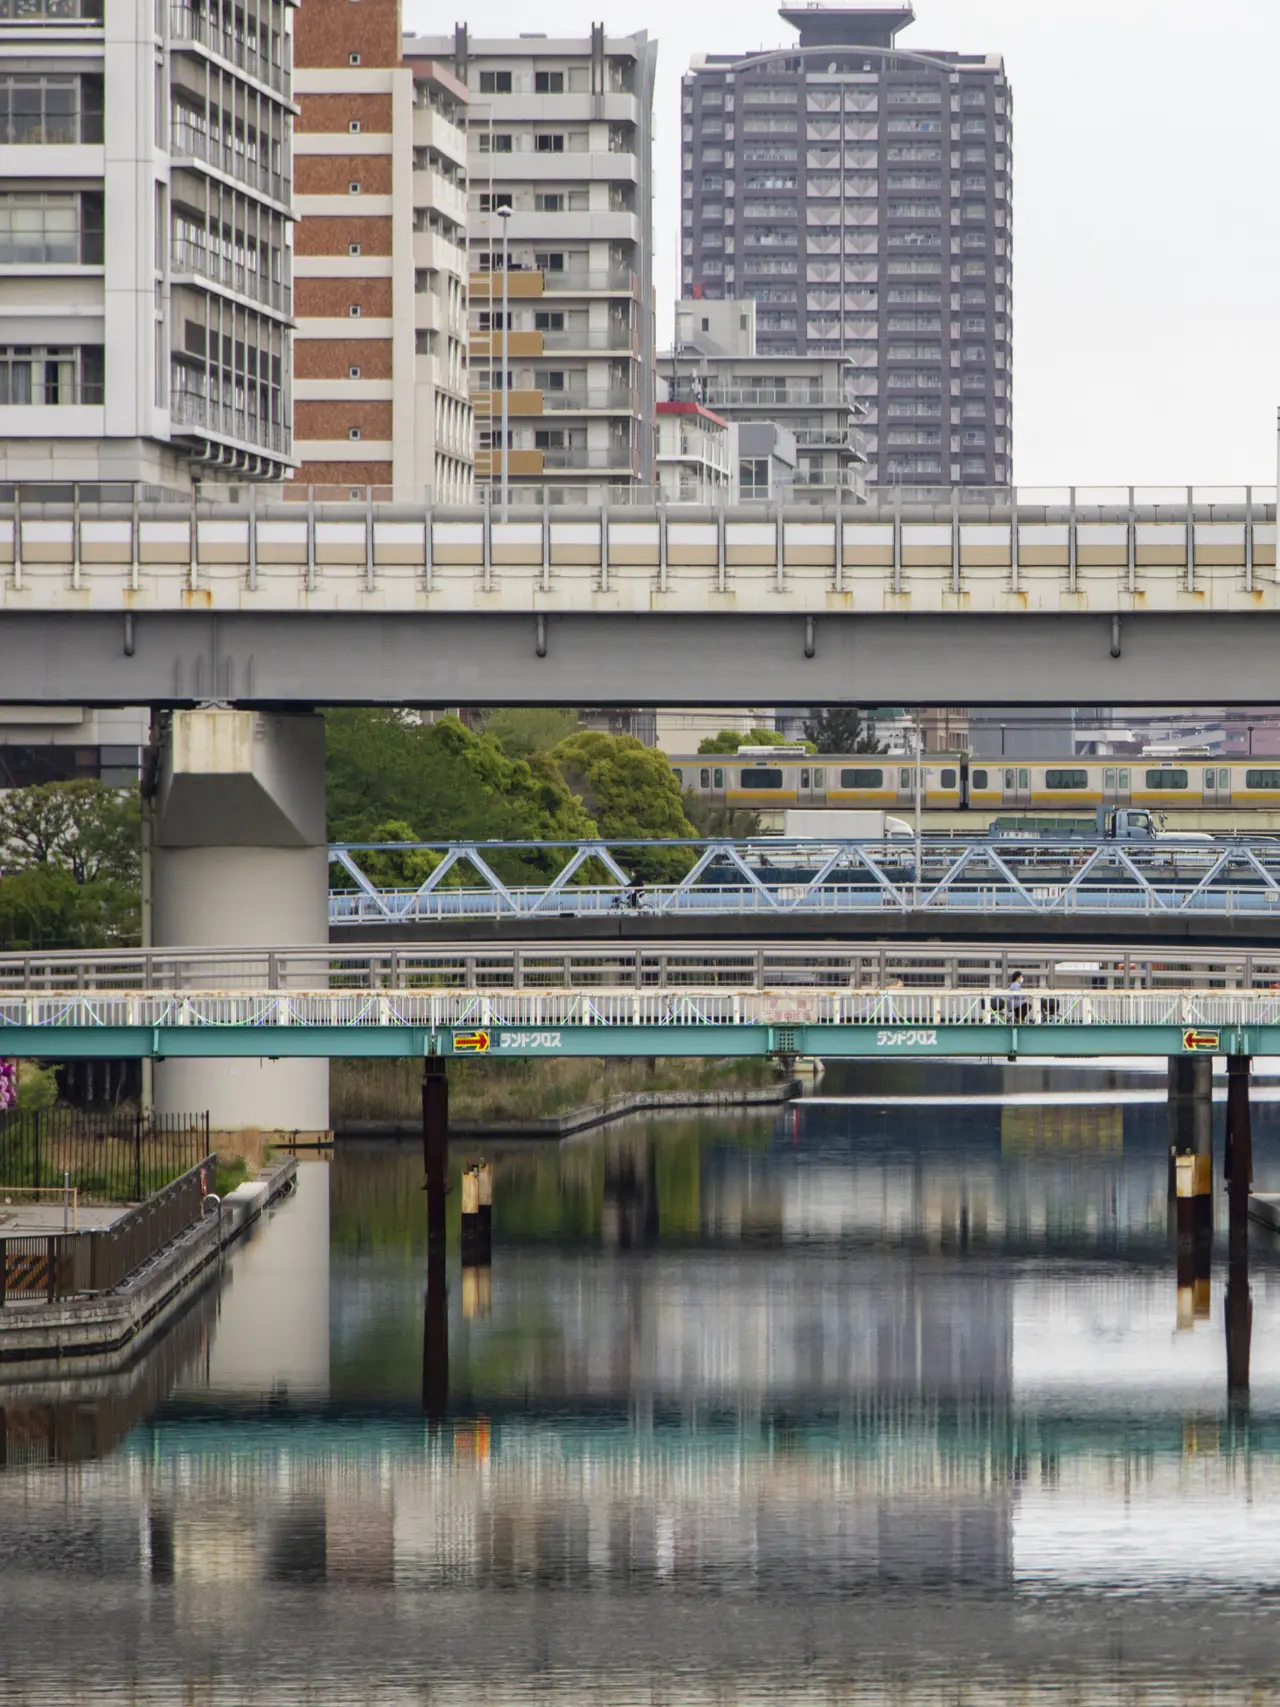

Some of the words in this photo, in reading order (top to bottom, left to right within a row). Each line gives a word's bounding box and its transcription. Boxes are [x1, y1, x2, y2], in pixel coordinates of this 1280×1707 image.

[500, 1032, 562, 1048] ランドクロス
[877, 1030, 938, 1045] ランドクロス
